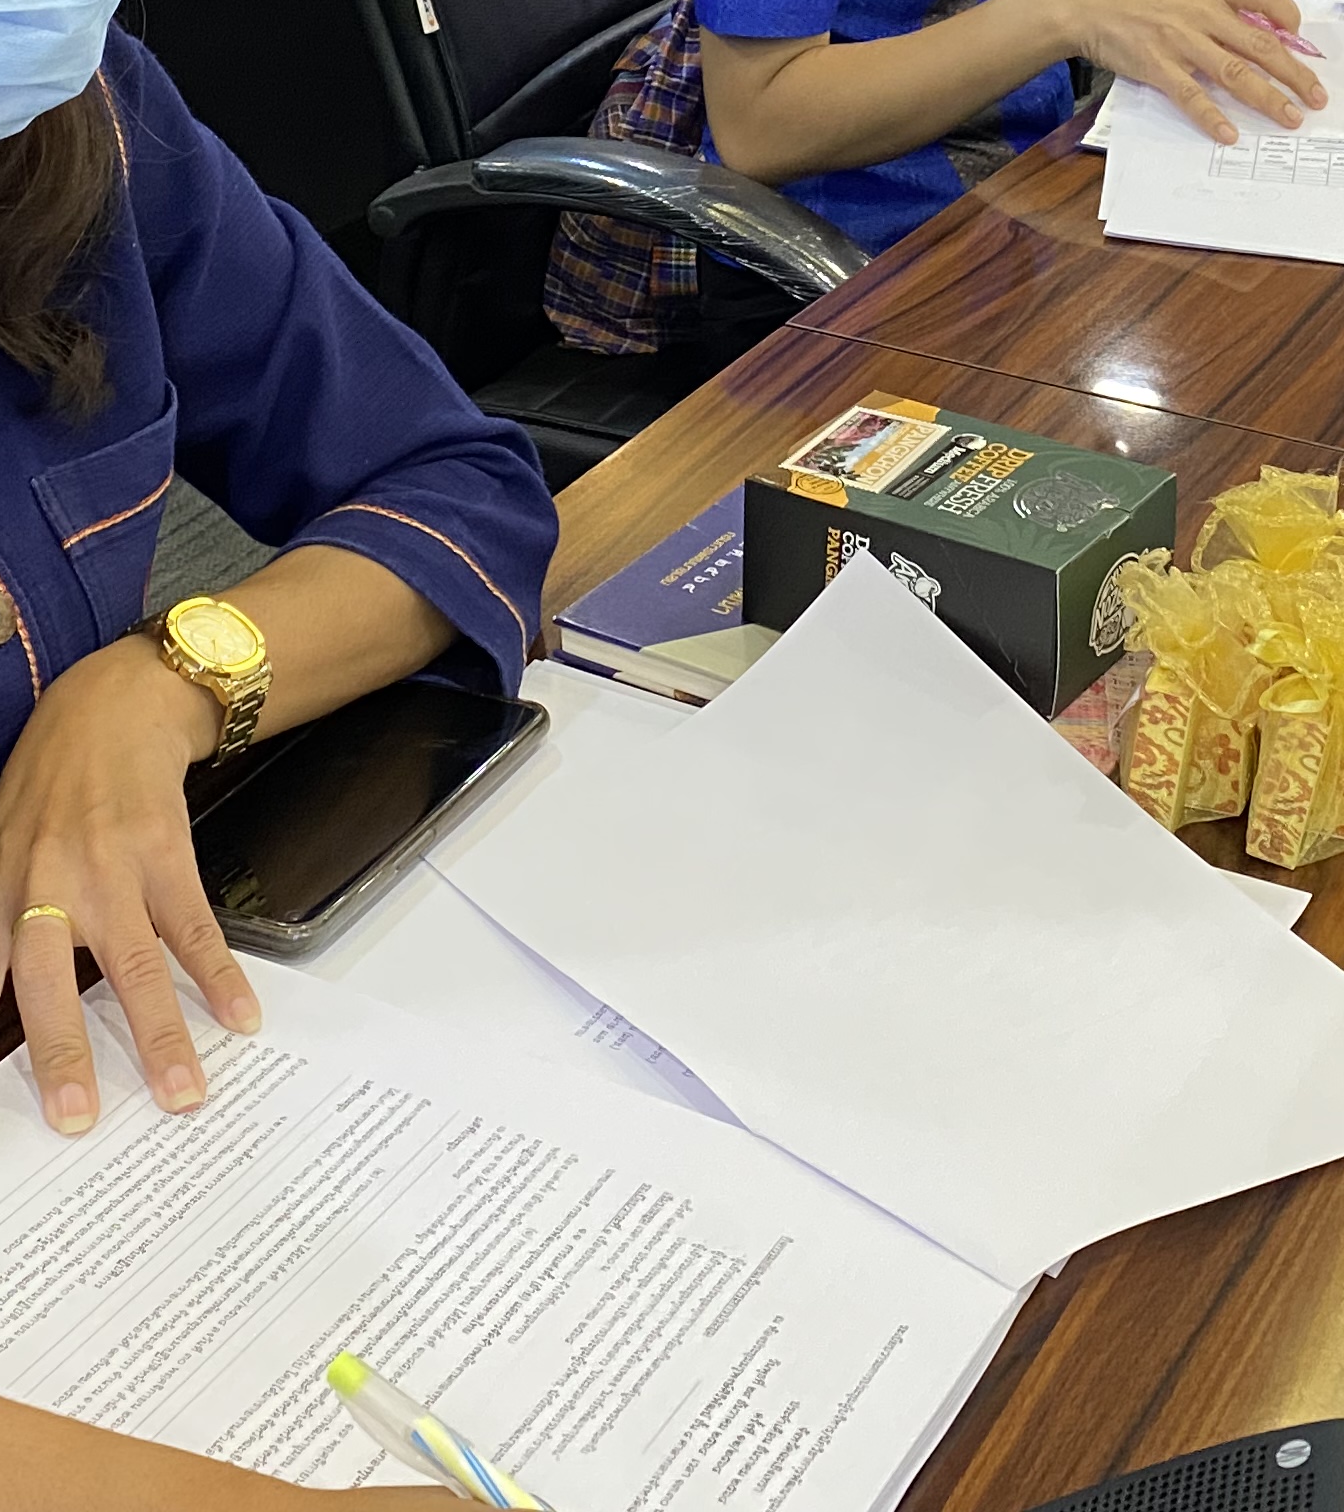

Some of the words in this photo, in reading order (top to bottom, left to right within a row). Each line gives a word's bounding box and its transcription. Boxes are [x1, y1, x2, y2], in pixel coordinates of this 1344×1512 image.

[859, 423, 931, 486] PANGKHON
[923, 441, 966, 476] Medium
[948, 440, 1008, 484] COFFEE
[992, 448, 1030, 479] DRIP
[941, 474, 1000, 517] FRESH
